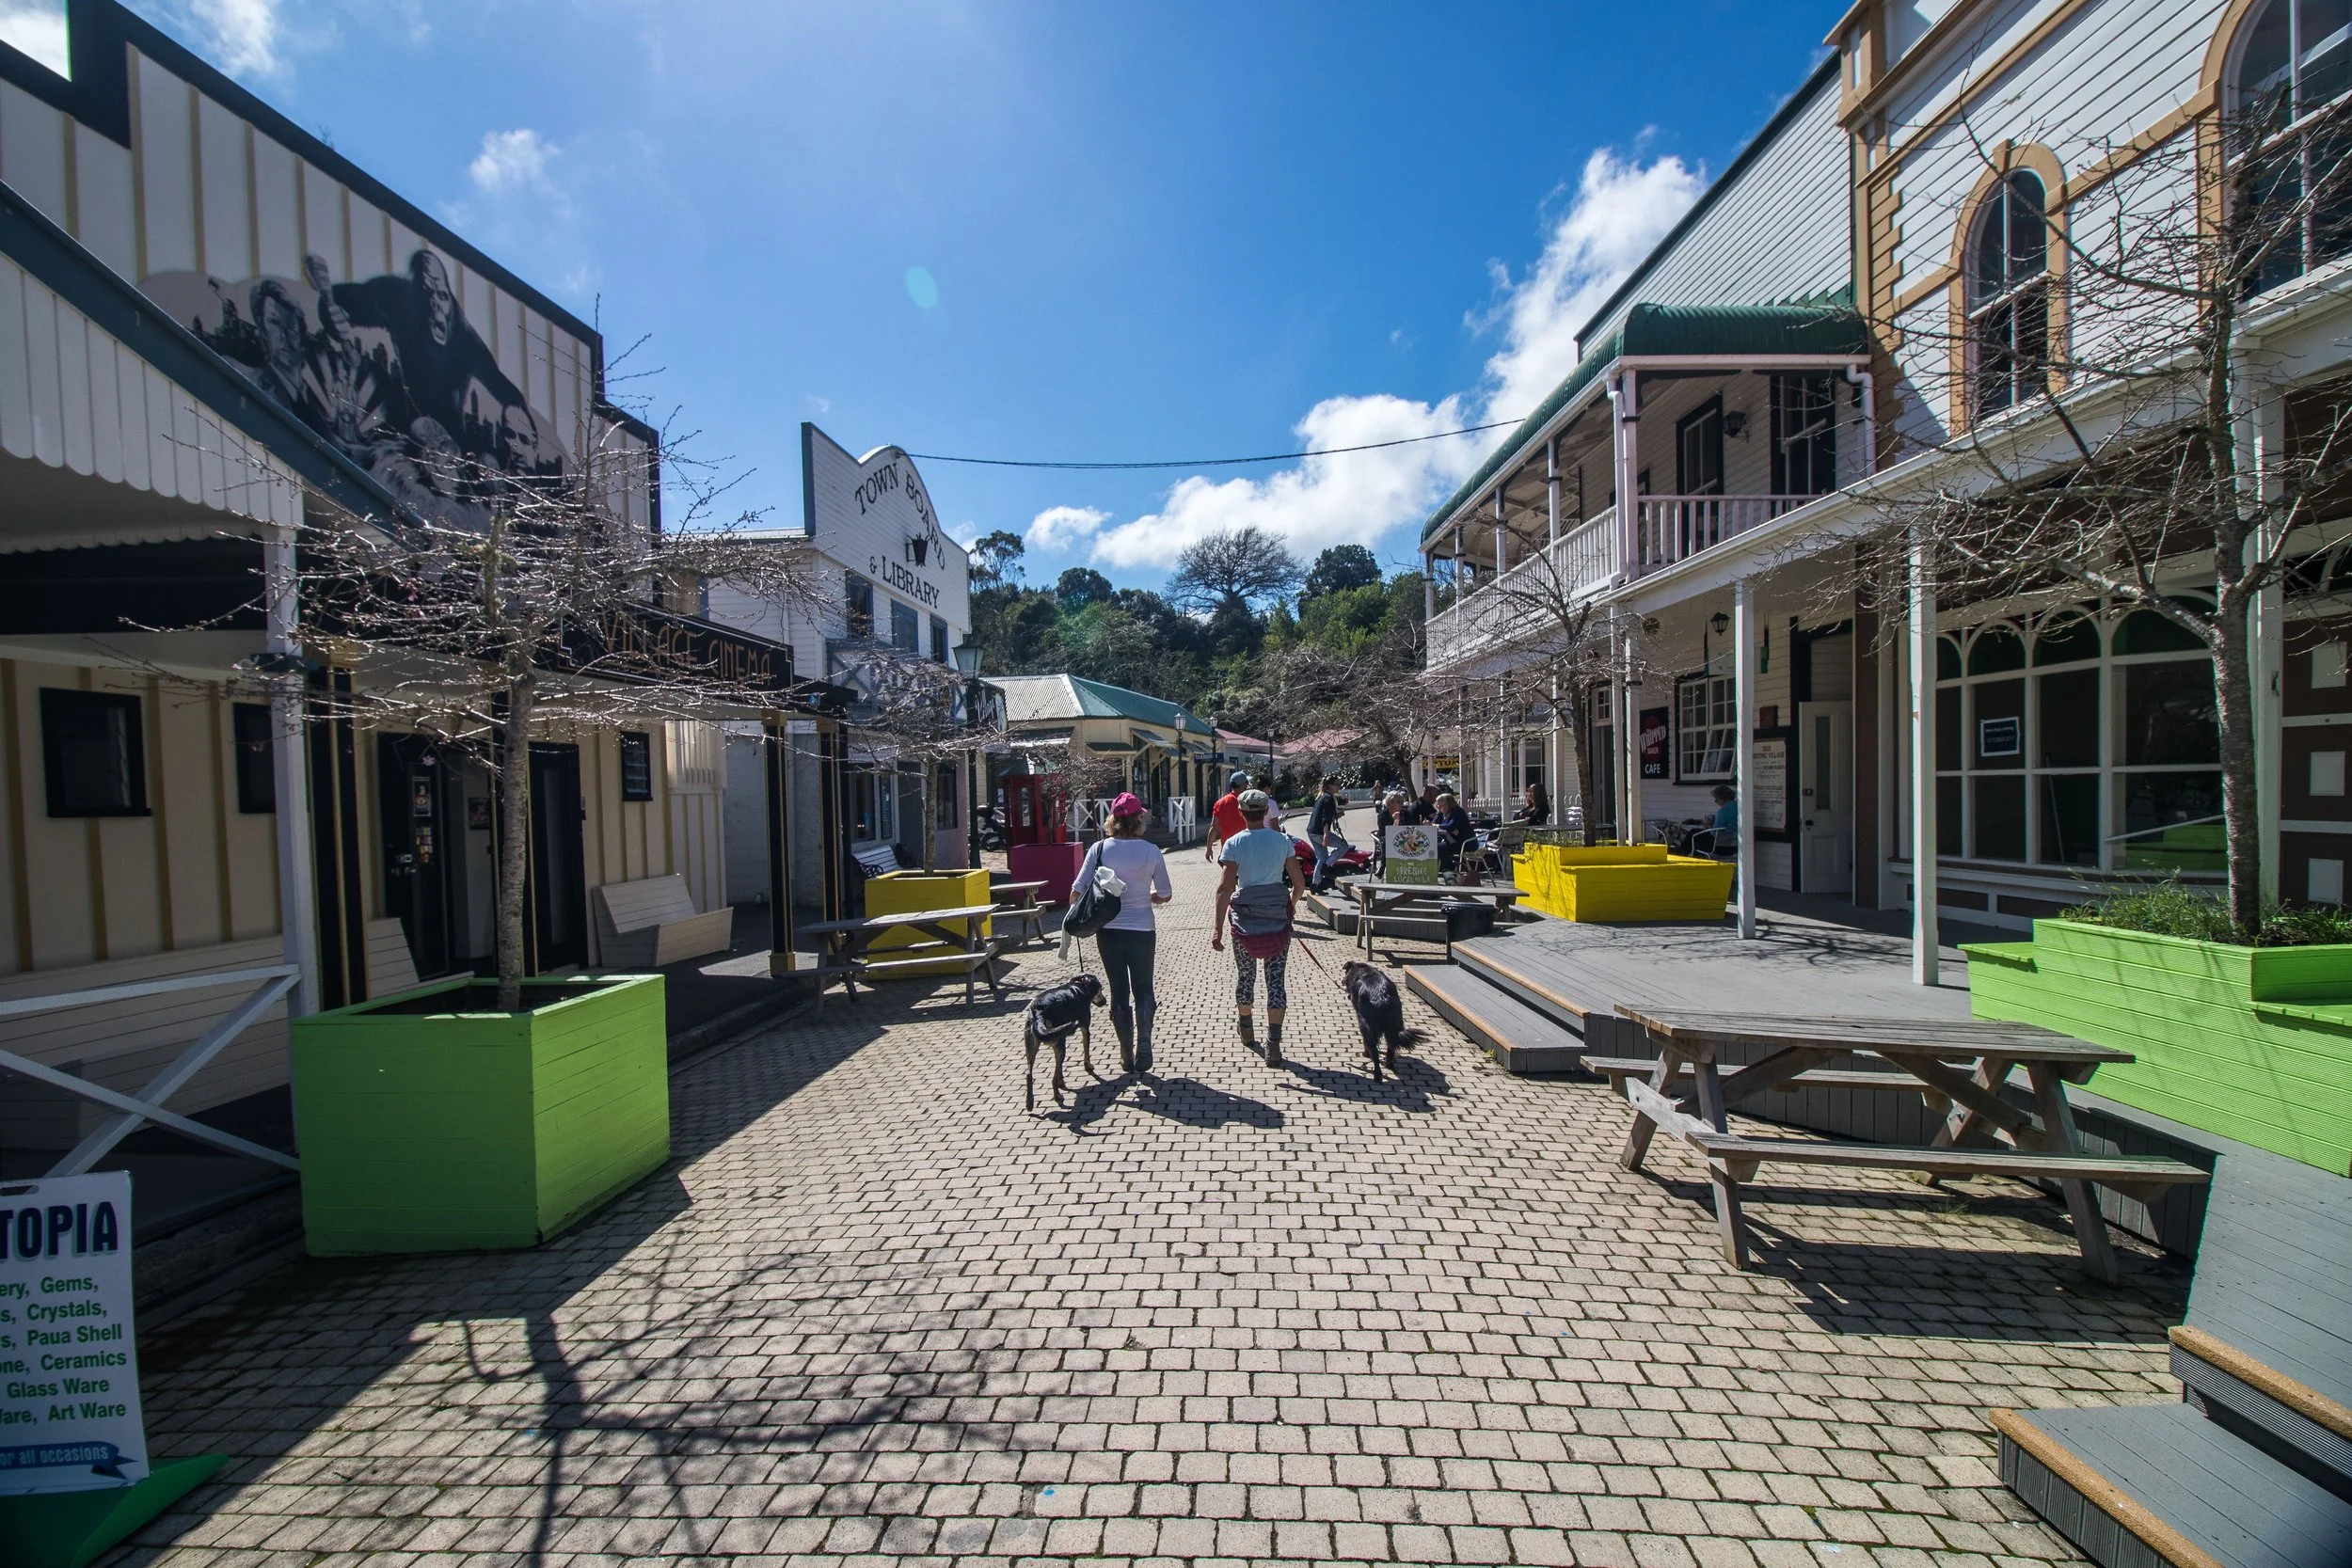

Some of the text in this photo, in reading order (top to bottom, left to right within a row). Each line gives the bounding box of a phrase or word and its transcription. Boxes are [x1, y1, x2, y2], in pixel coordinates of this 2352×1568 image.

[855, 463, 946, 571] TOWN BOARD
[869, 555, 940, 609] & LIBRARY
[708, 640, 771, 686] CINEMA
[1645, 764, 1661, 774] CAFE
[1400, 867, 1422, 876] FRESH
[40, 1275, 99, 1293] Gems,
[26, 1300, 107, 1323] Crystals,
[27, 1329, 72, 1346] Paua
[76, 1323, 122, 1342] Shell
[40, 1351, 127, 1371] Ceramics
[7, 1377, 110, 1399] Glass Ware
[48, 1404, 75, 1421] Art
[79, 1402, 127, 1419] Ware
[19, 1449, 36, 1465] all
[40, 1446, 109, 1464] occasions
